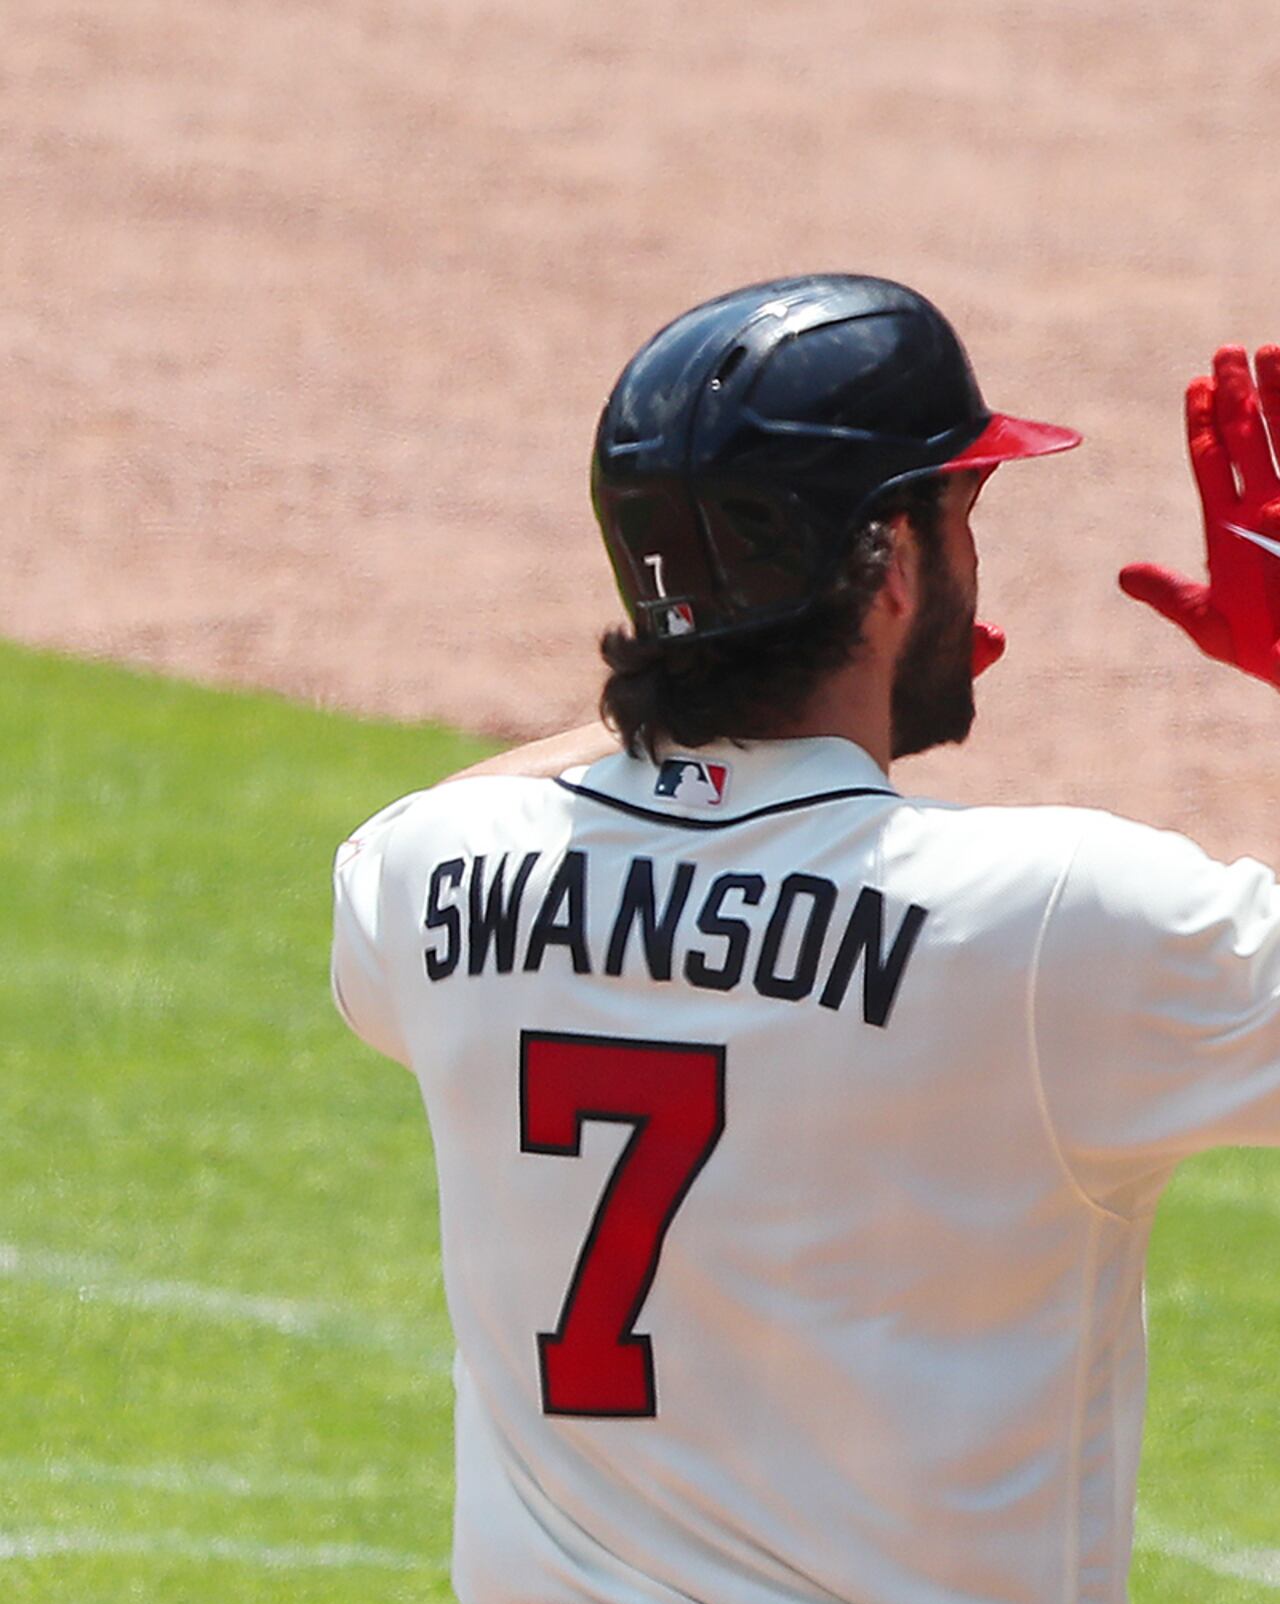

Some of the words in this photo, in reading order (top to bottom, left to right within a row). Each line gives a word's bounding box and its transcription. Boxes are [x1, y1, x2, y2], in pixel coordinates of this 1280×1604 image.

[643, 553, 667, 598] 7
[424, 850, 928, 1028] SWANSON
[519, 1029, 727, 1417] 7
